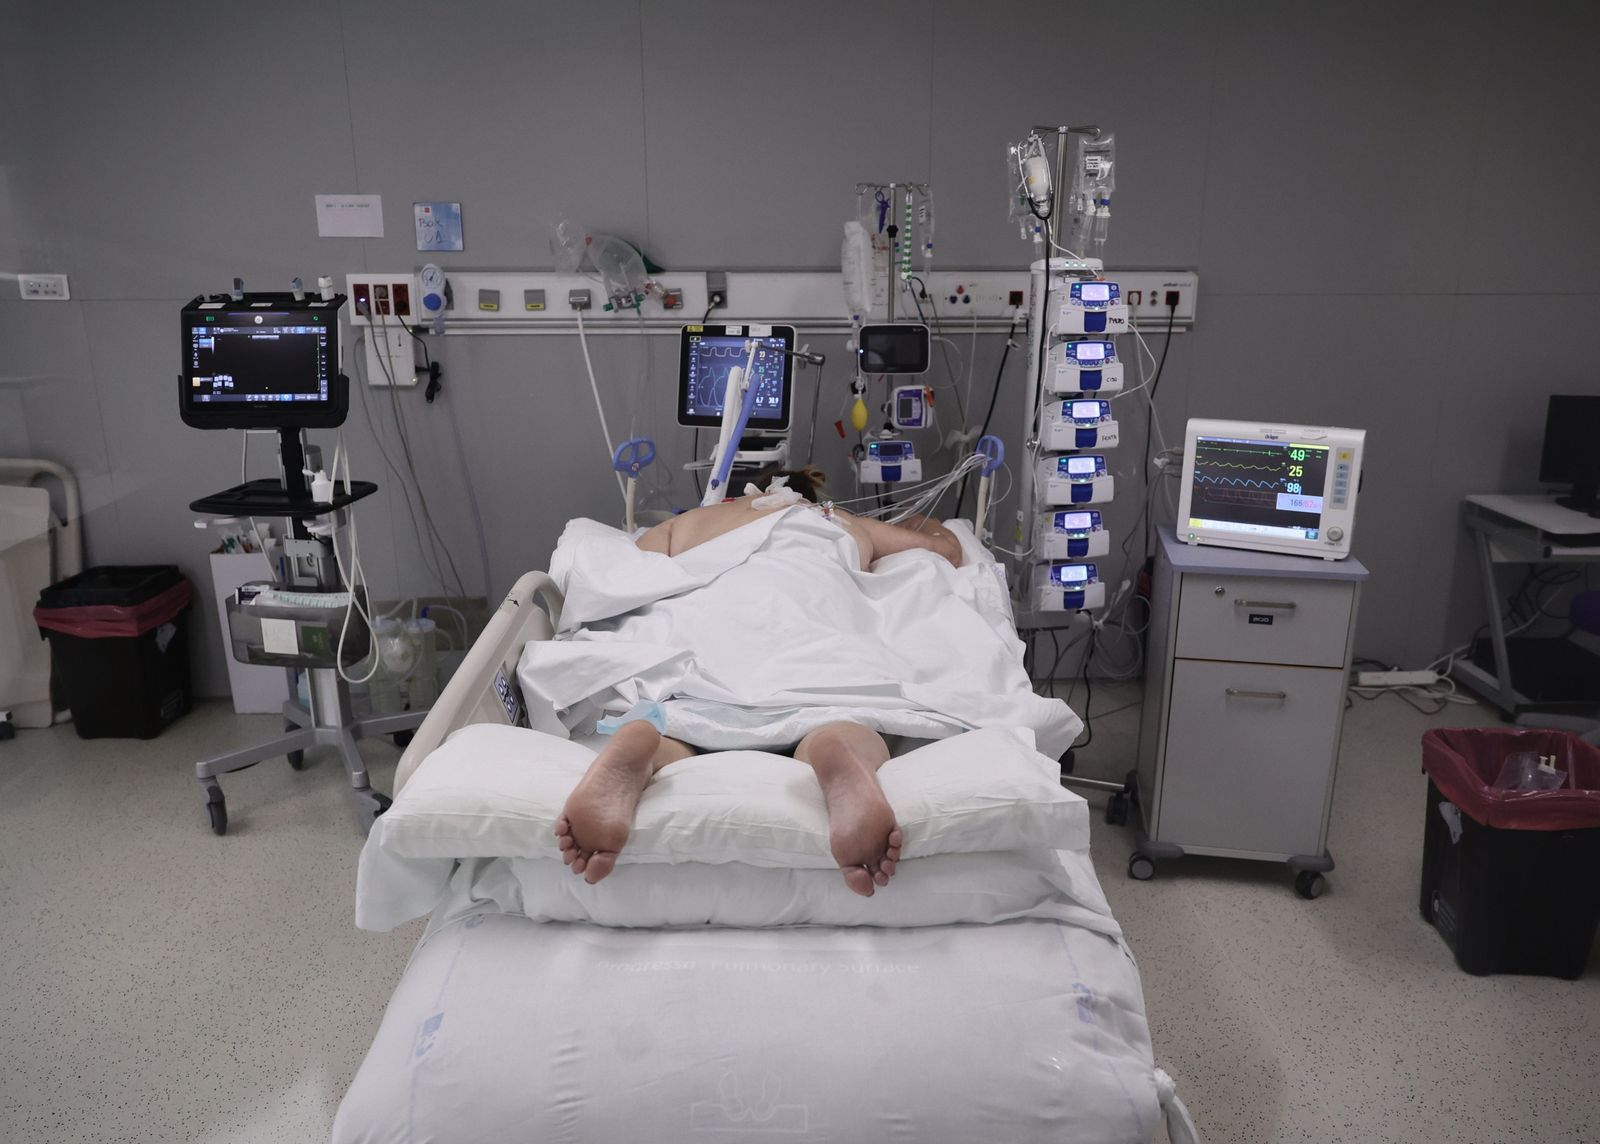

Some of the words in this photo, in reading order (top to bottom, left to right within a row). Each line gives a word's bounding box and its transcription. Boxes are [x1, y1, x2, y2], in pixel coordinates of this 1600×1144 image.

[1290, 449, 1305, 461] 49
[1288, 465, 1303, 477] 25
[1286, 482, 1300, 493] 98
